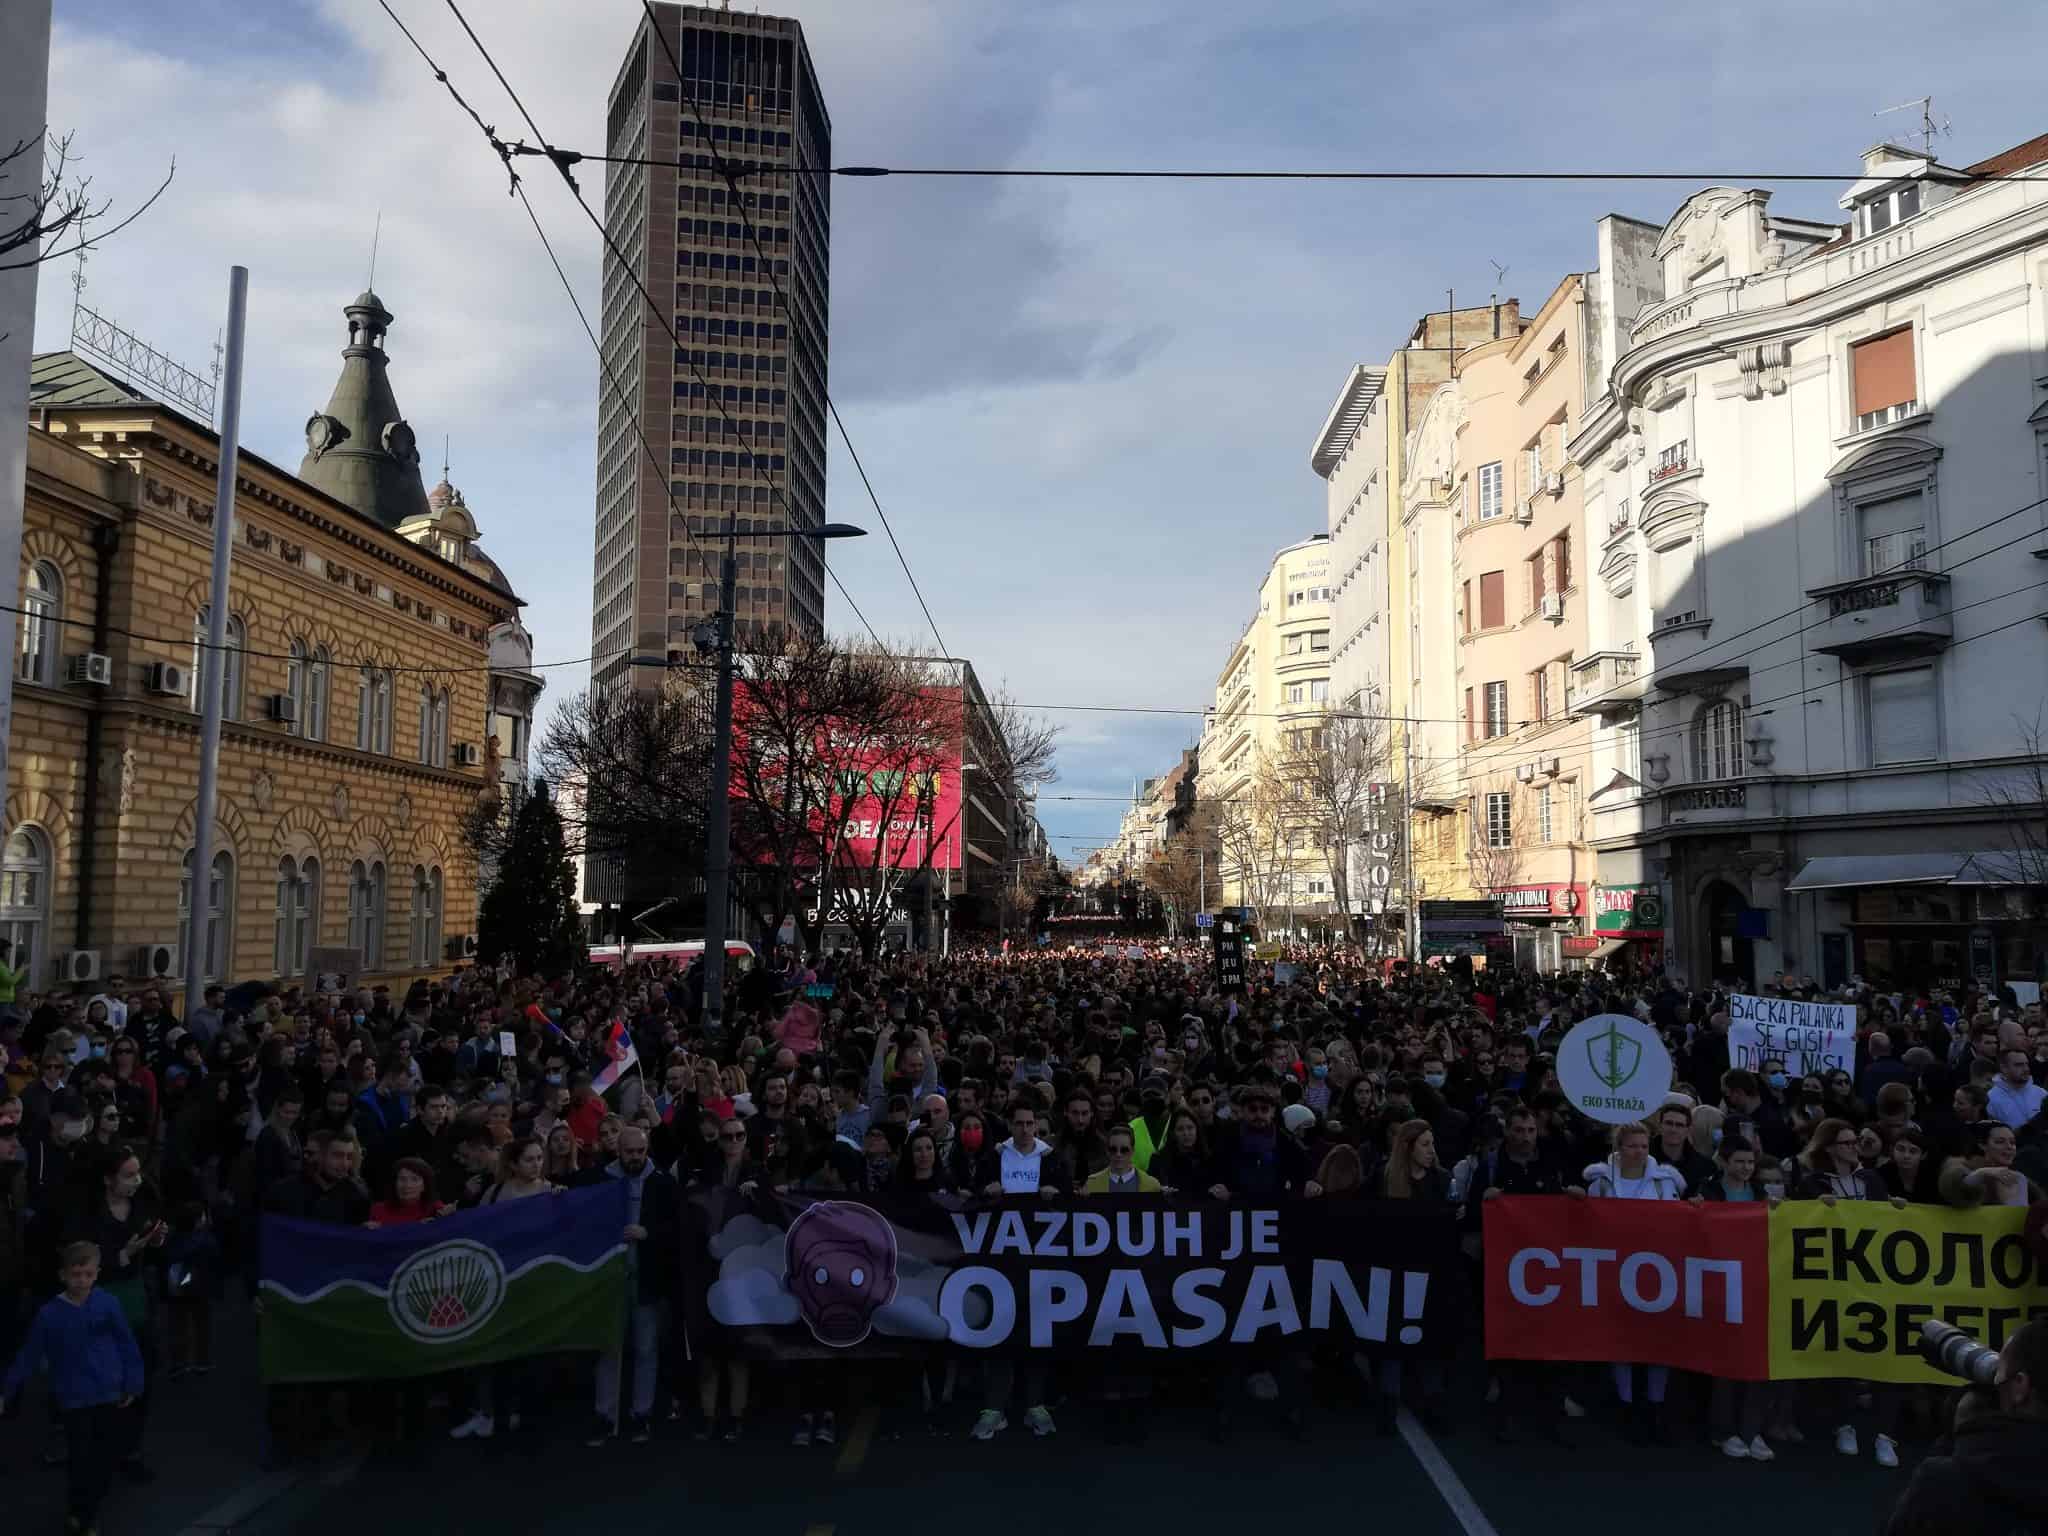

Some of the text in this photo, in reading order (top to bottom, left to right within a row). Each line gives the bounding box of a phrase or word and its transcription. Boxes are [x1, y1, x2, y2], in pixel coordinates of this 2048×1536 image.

[1604, 889, 1633, 911] MAXB
[1222, 941, 1234, 951] PM
[1222, 958, 1237, 969] JE U
[1222, 974, 1241, 984] 3 PM
[1791, 1003, 1845, 1031] PALANKA
[1755, 1023, 1776, 1048] SE
[1582, 1095, 1645, 1112] EKO STRAŽA
[951, 1209, 1280, 1261] VAZDUH JE
[1792, 1227, 2048, 1289] ЕКОЛО
[1508, 1247, 1744, 1324] СТОП
[938, 1258, 1430, 1349] OPASAN!
[1791, 1298, 2048, 1355] ИЗБЕГ
